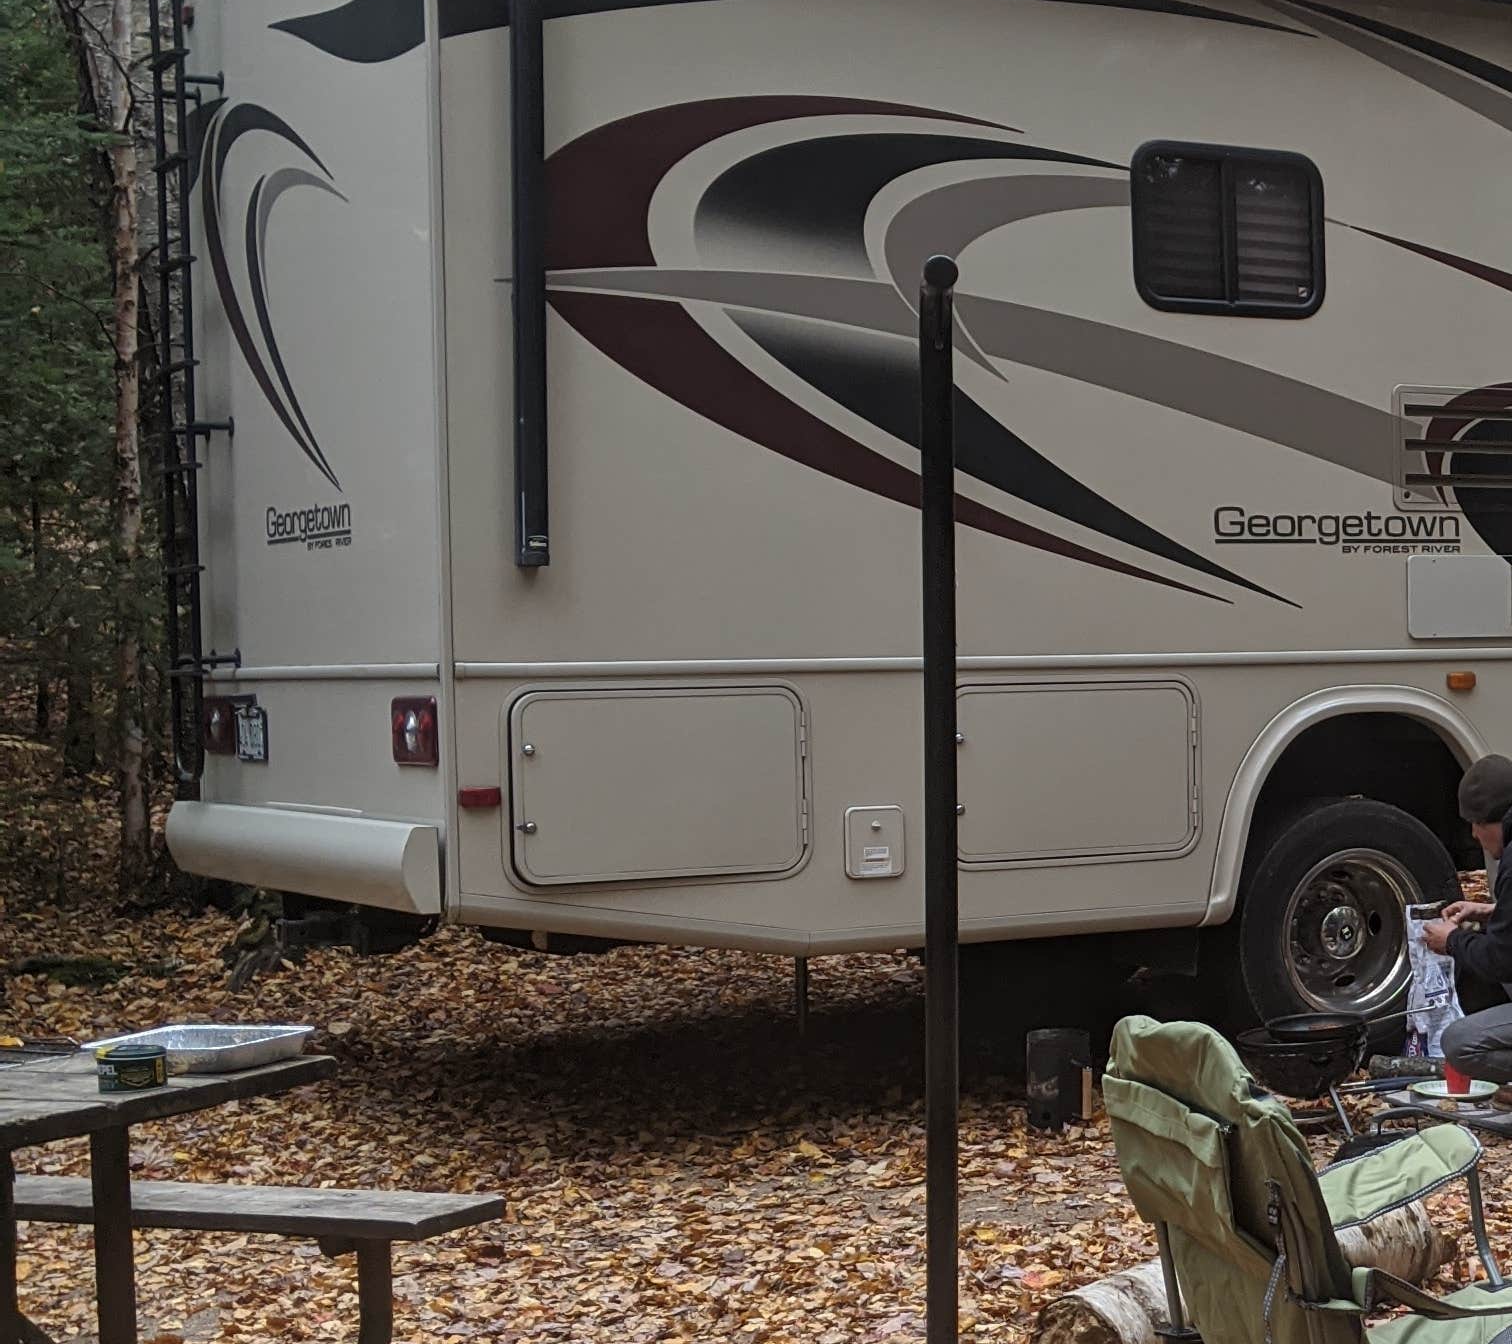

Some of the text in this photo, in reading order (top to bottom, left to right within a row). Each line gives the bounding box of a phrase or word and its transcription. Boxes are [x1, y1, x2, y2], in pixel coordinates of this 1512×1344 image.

[266, 503, 351, 544] Georgetown
[1213, 506, 1461, 545] Georgetown
[1342, 545, 1461, 554] BY FOREST RIVER
